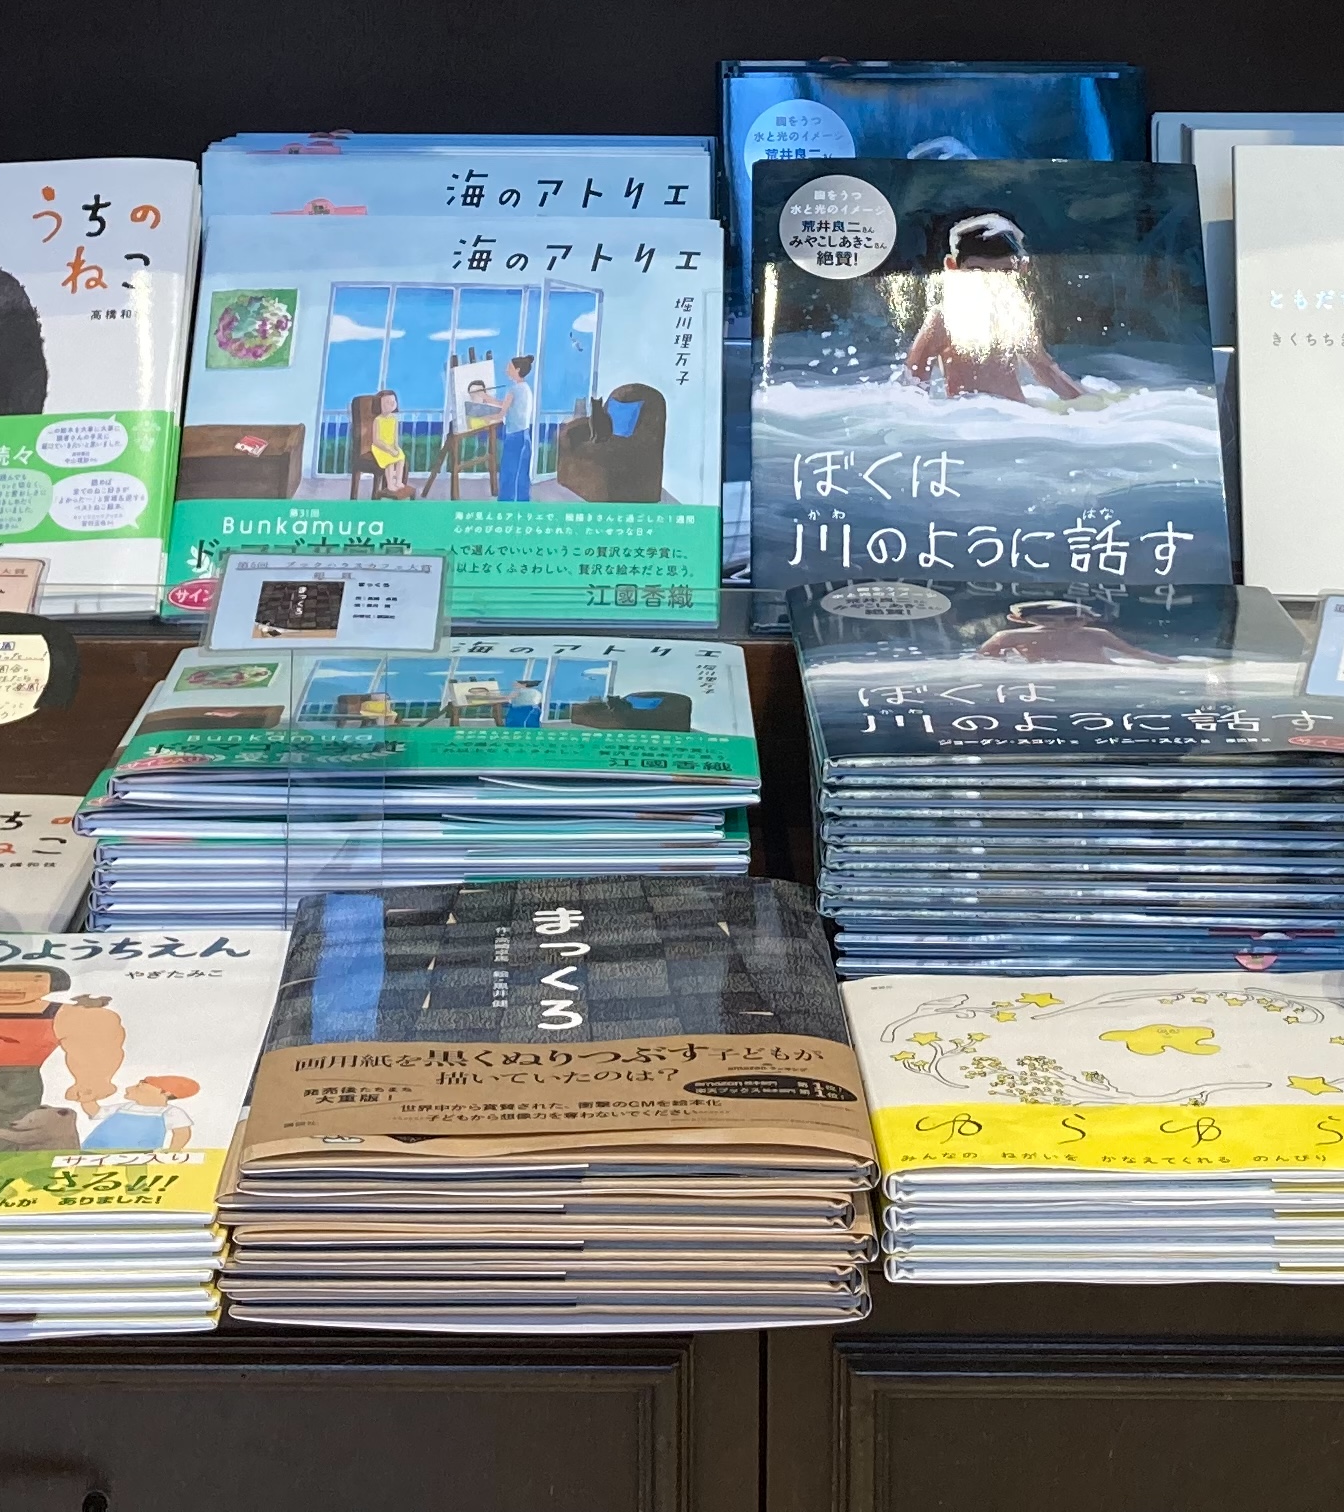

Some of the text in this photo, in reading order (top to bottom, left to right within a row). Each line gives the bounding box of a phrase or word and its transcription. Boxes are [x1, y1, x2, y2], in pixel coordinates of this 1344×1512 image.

[446, 169, 690, 210] 海のアトリエ
[32, 186, 161, 243] うちの
[451, 234, 702, 273] 海のアトリエ
[674, 297, 694, 386] 堀川理万子
[792, 449, 965, 500] ぼくは
[222, 516, 384, 537] Bunkamura
[788, 517, 1195, 576] 川のように話す
[586, 583, 694, 609] 江國香織
[859, 684, 1056, 706] ぼくは
[861, 708, 1334, 734] 川のように話す
[532, 906, 591, 1032] まっくろ
[295, 1044, 824, 1073] 画用紙を黒くぬりつぶす子どもが
[435, 1067, 679, 1085] 描いていたのは?
